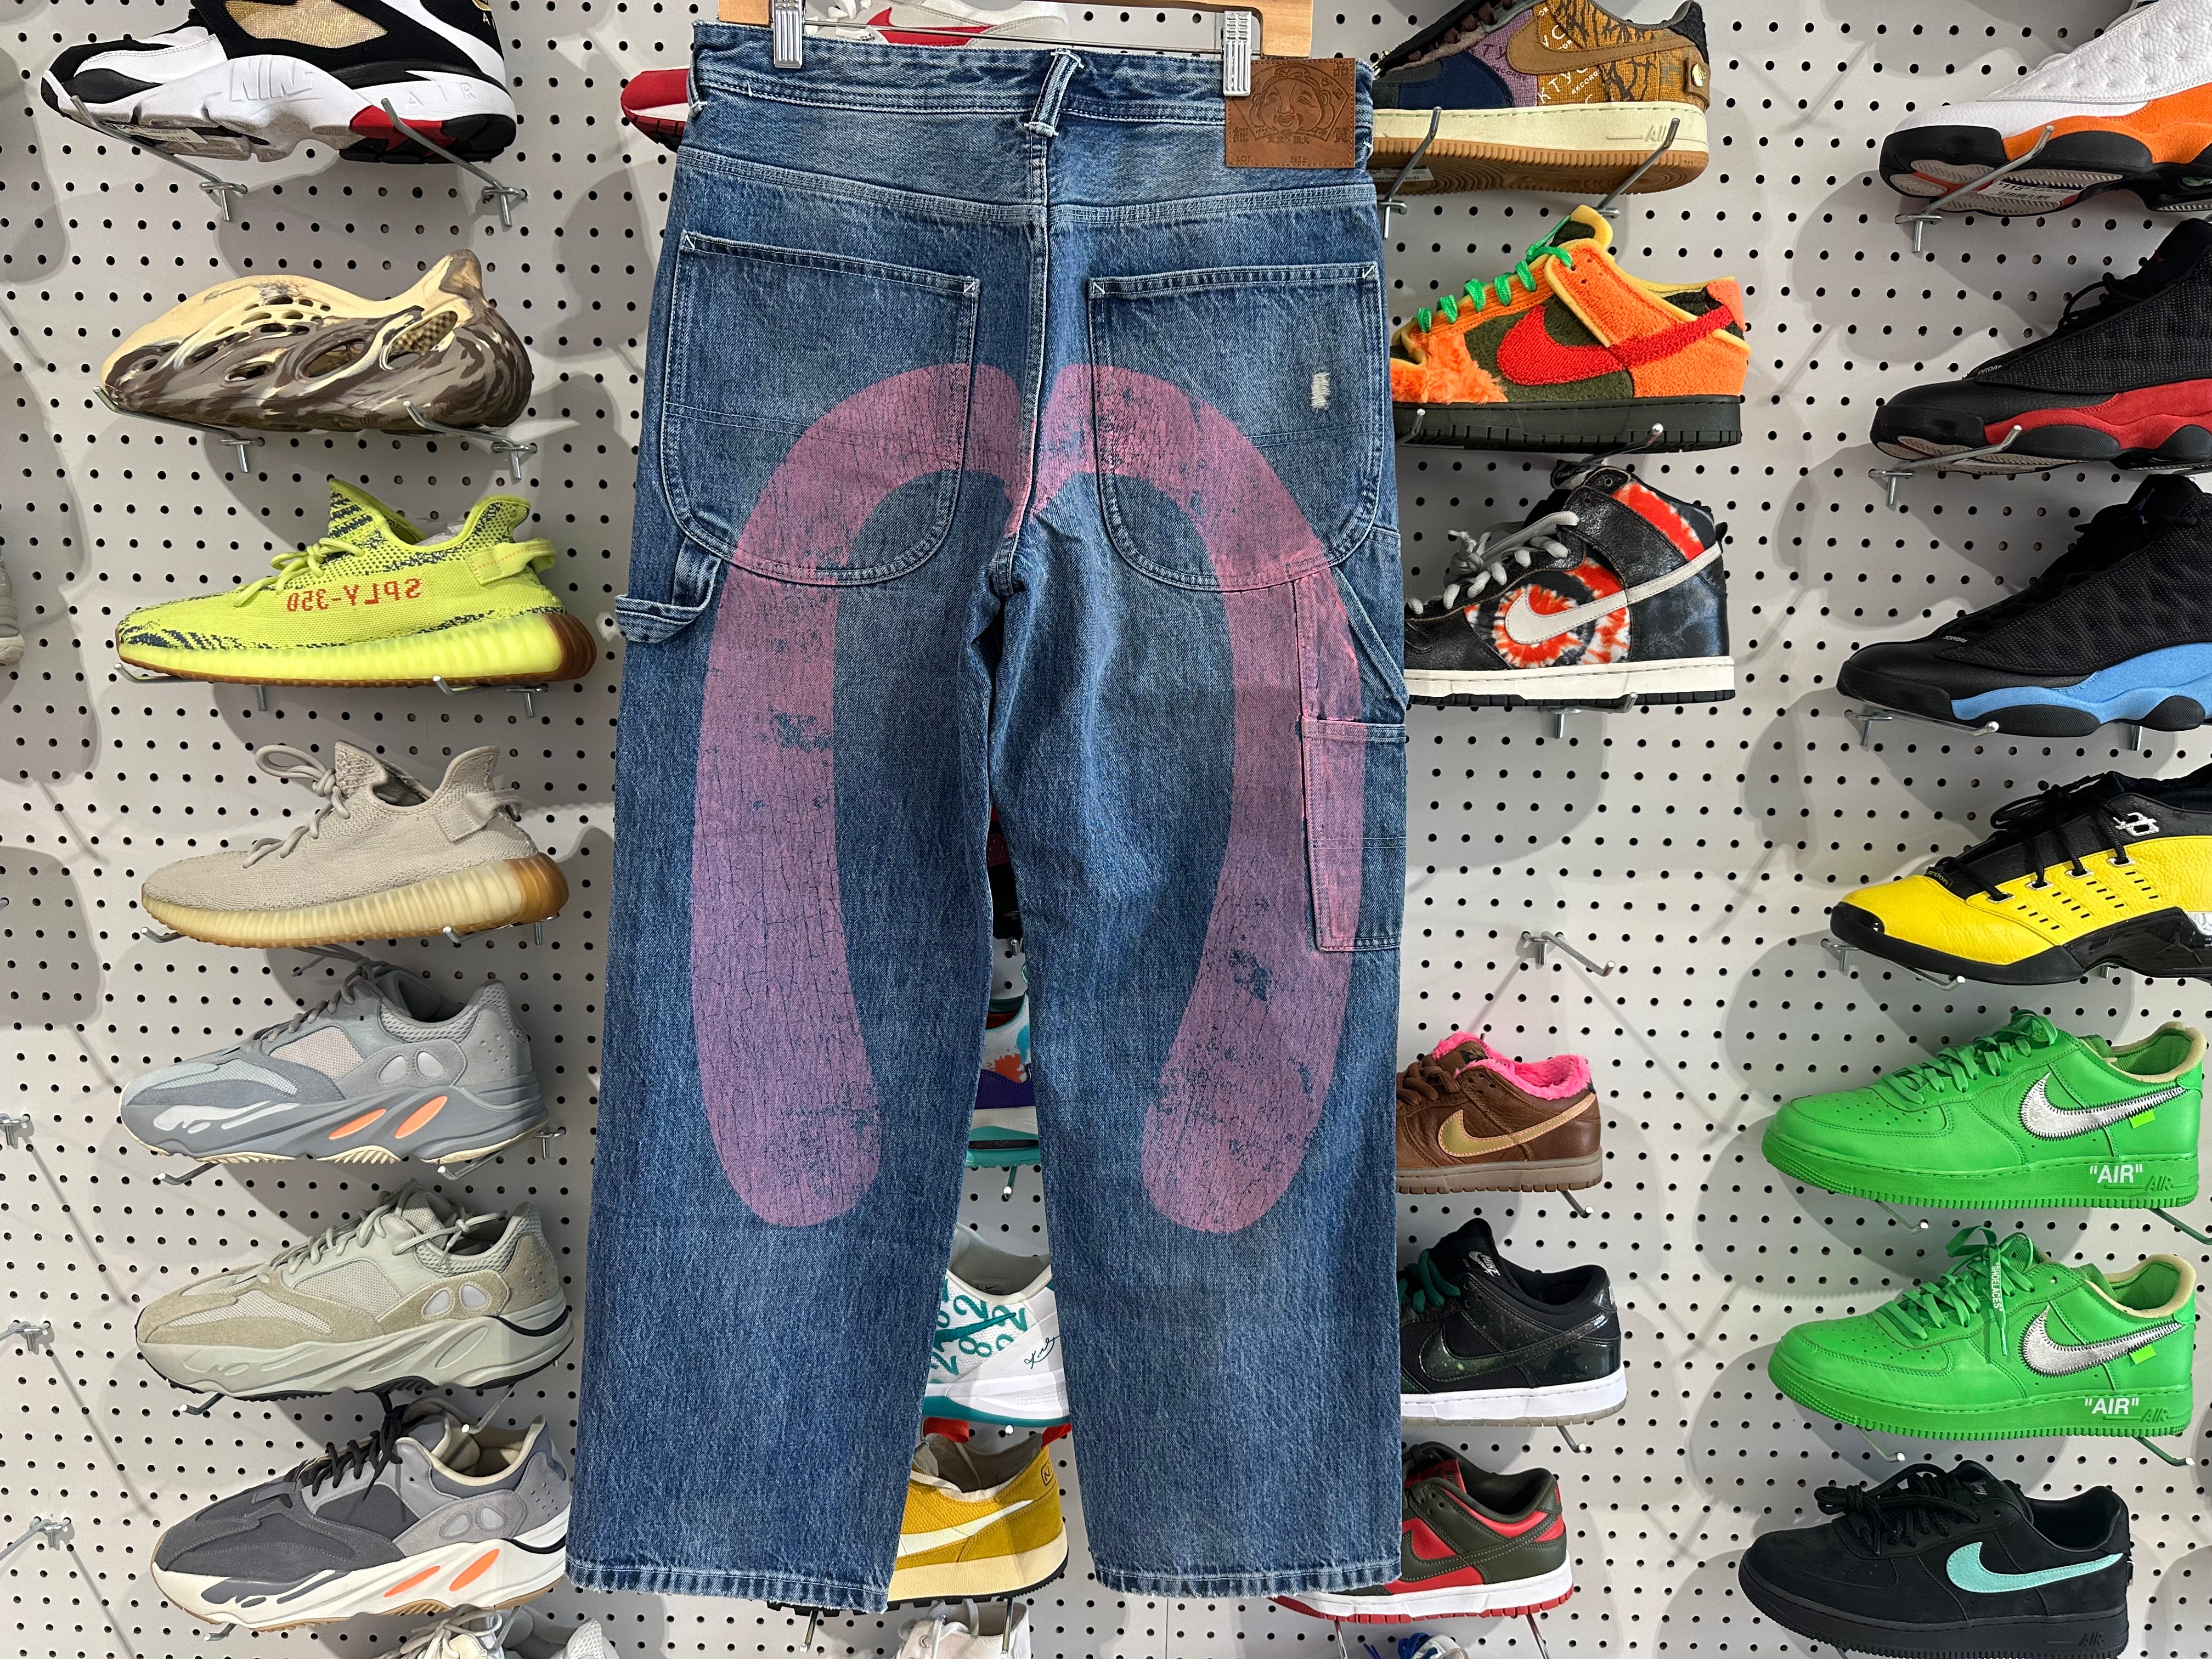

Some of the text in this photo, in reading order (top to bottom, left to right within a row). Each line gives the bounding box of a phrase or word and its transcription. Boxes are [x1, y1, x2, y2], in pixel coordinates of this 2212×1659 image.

[230, 55, 314, 103] NIKE
[406, 82, 477, 111] AIR
[1645, 125, 1669, 142] AI
[2089, 1164, 2143, 1183] "AIR"
[2145, 1175, 2173, 1192] AIR
[1990, 1261, 2004, 1312] "SHOELACES"
[2084, 1397, 2140, 1415] "AIR"
[2141, 1407, 2169, 1423] AIR
